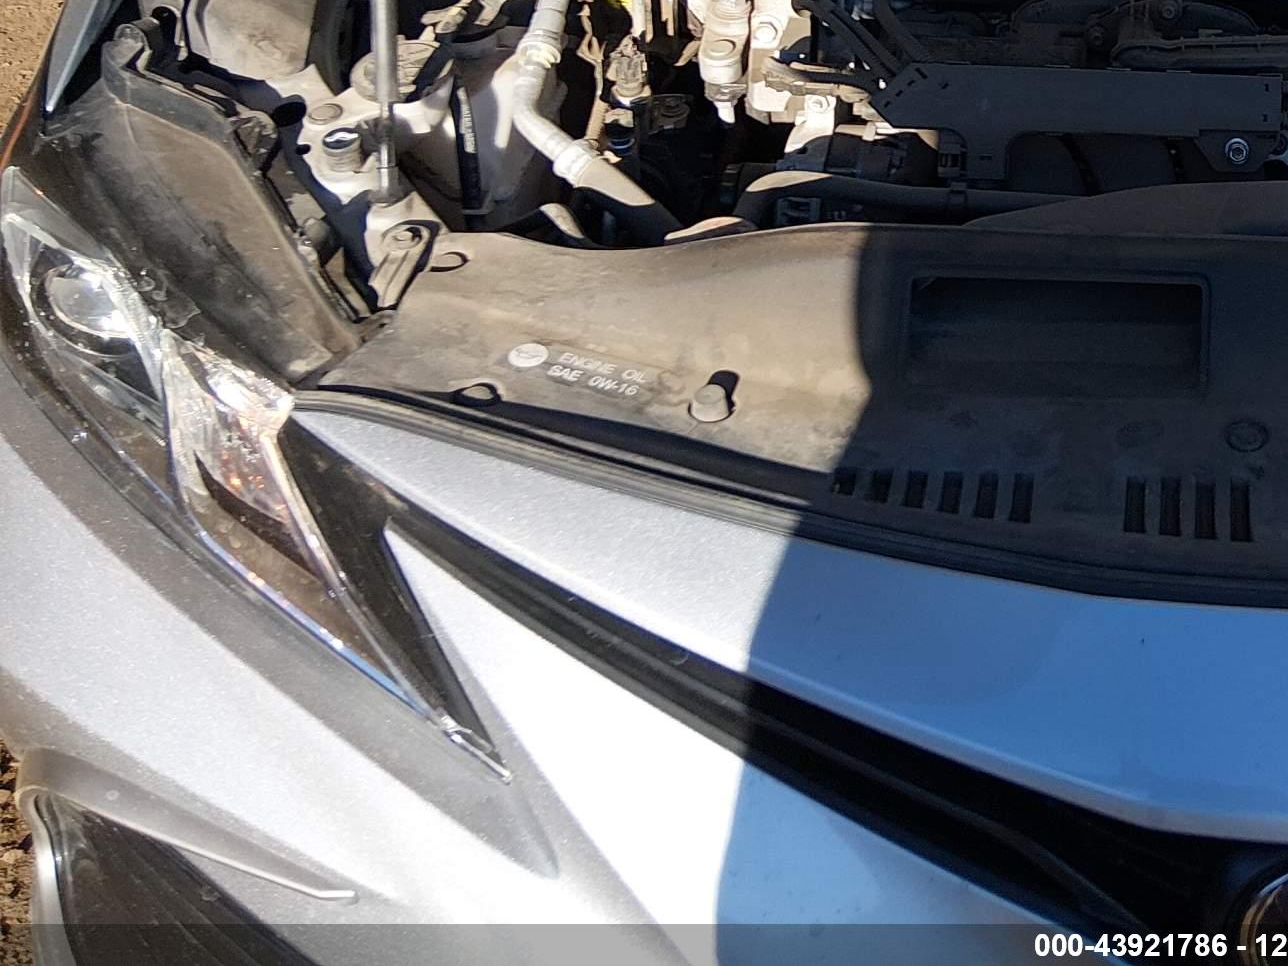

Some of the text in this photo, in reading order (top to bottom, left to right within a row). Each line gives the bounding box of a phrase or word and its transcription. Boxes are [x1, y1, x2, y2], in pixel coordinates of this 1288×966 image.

[547, 364, 640, 396] SAE 0W-16
[559, 352, 648, 383] ENGINE OIL
